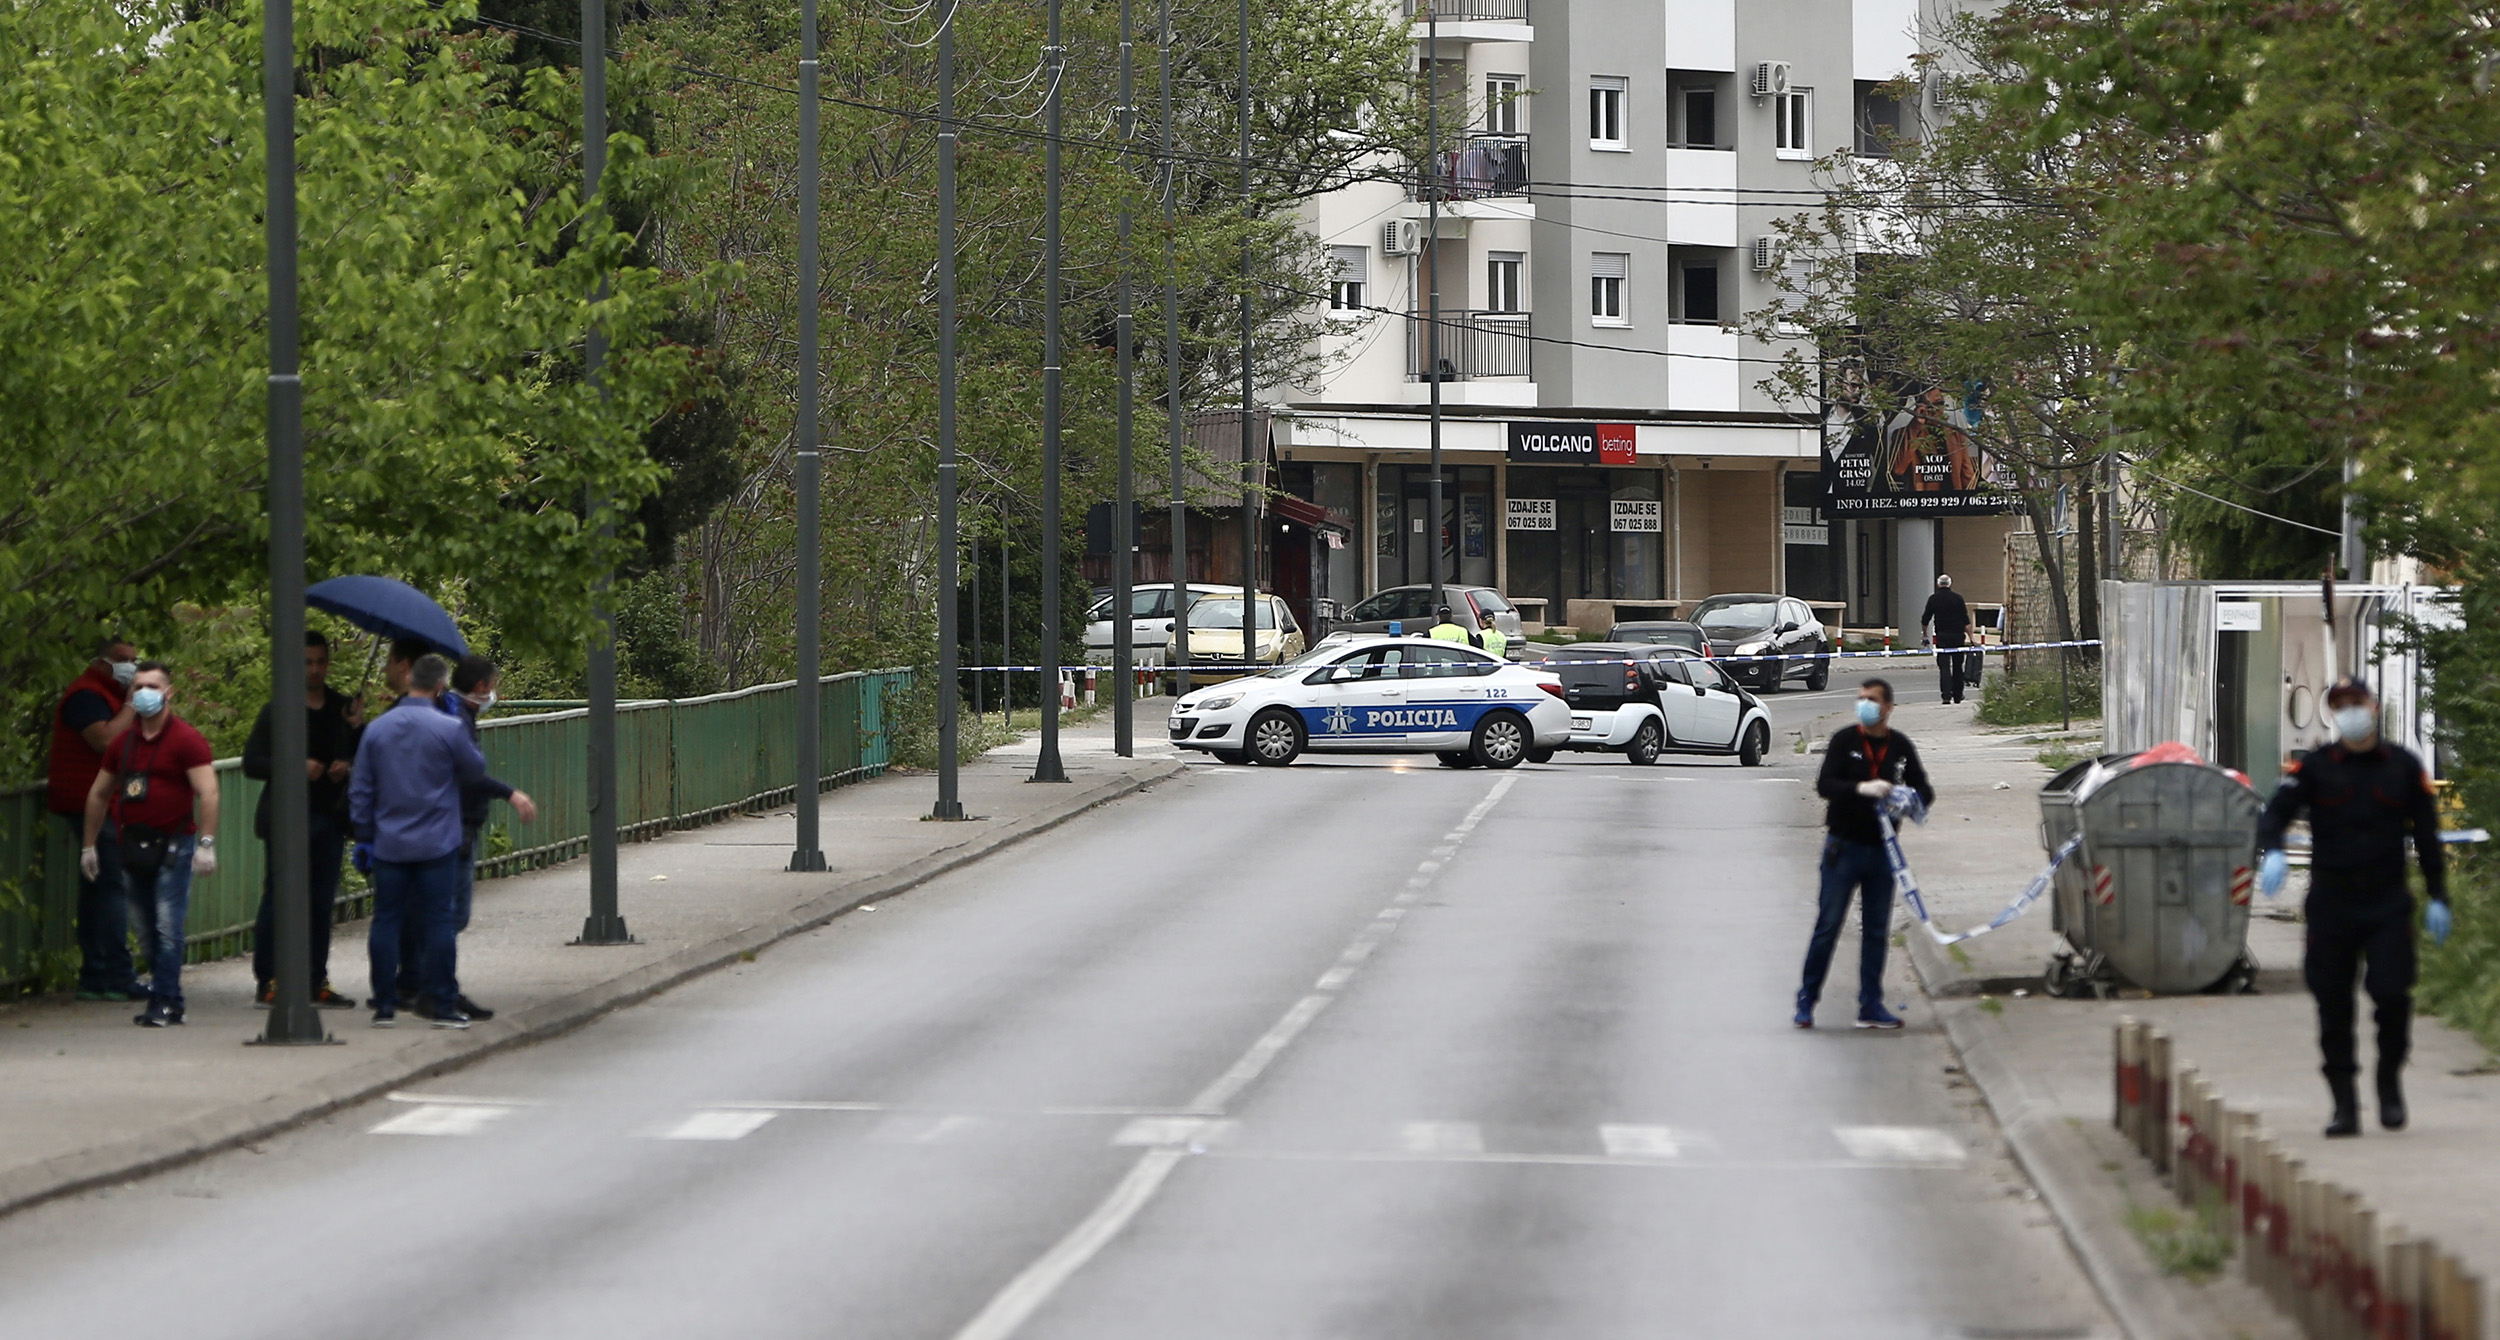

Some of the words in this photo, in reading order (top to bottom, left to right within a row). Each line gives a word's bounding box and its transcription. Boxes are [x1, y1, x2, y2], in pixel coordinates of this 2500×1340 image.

[1520, 434, 1593, 453] VOLCANO
[1602, 434, 1633, 457] betting
[1840, 459, 1870, 468] PETAR
[1924, 455, 1943, 463] ACO
[1839, 467, 1871, 478] GRAŠO
[1915, 462, 1953, 474] PEJOVIĆ
[1846, 479, 1866, 487] 14.02
[1923, 474, 1944, 482] 08.03
[1508, 501, 1538, 514] IZDAJE
[1540, 501, 1552, 514] SE
[1836, 499, 1863, 509] INFO
[1865, 499, 1869, 509] I
[1872, 498, 1897, 508] REZ.:
[1900, 497, 1918, 507] 069
[1920, 497, 1939, 507] 929
[1941, 497, 1960, 507] 929
[1969, 495, 1988, 506] 063
[1614, 502, 1644, 516] IZDAJE
[1645, 503, 1657, 516] SE
[1508, 516, 1521, 528] 067
[1522, 516, 1537, 528] 025
[1538, 516, 1552, 528] 888
[1613, 518, 1627, 530] 067
[1628, 518, 1642, 530] 025
[1643, 518, 1657, 530] 888
[1485, 688, 1508, 699] 122
[1366, 709, 1458, 729] POLICIJA
